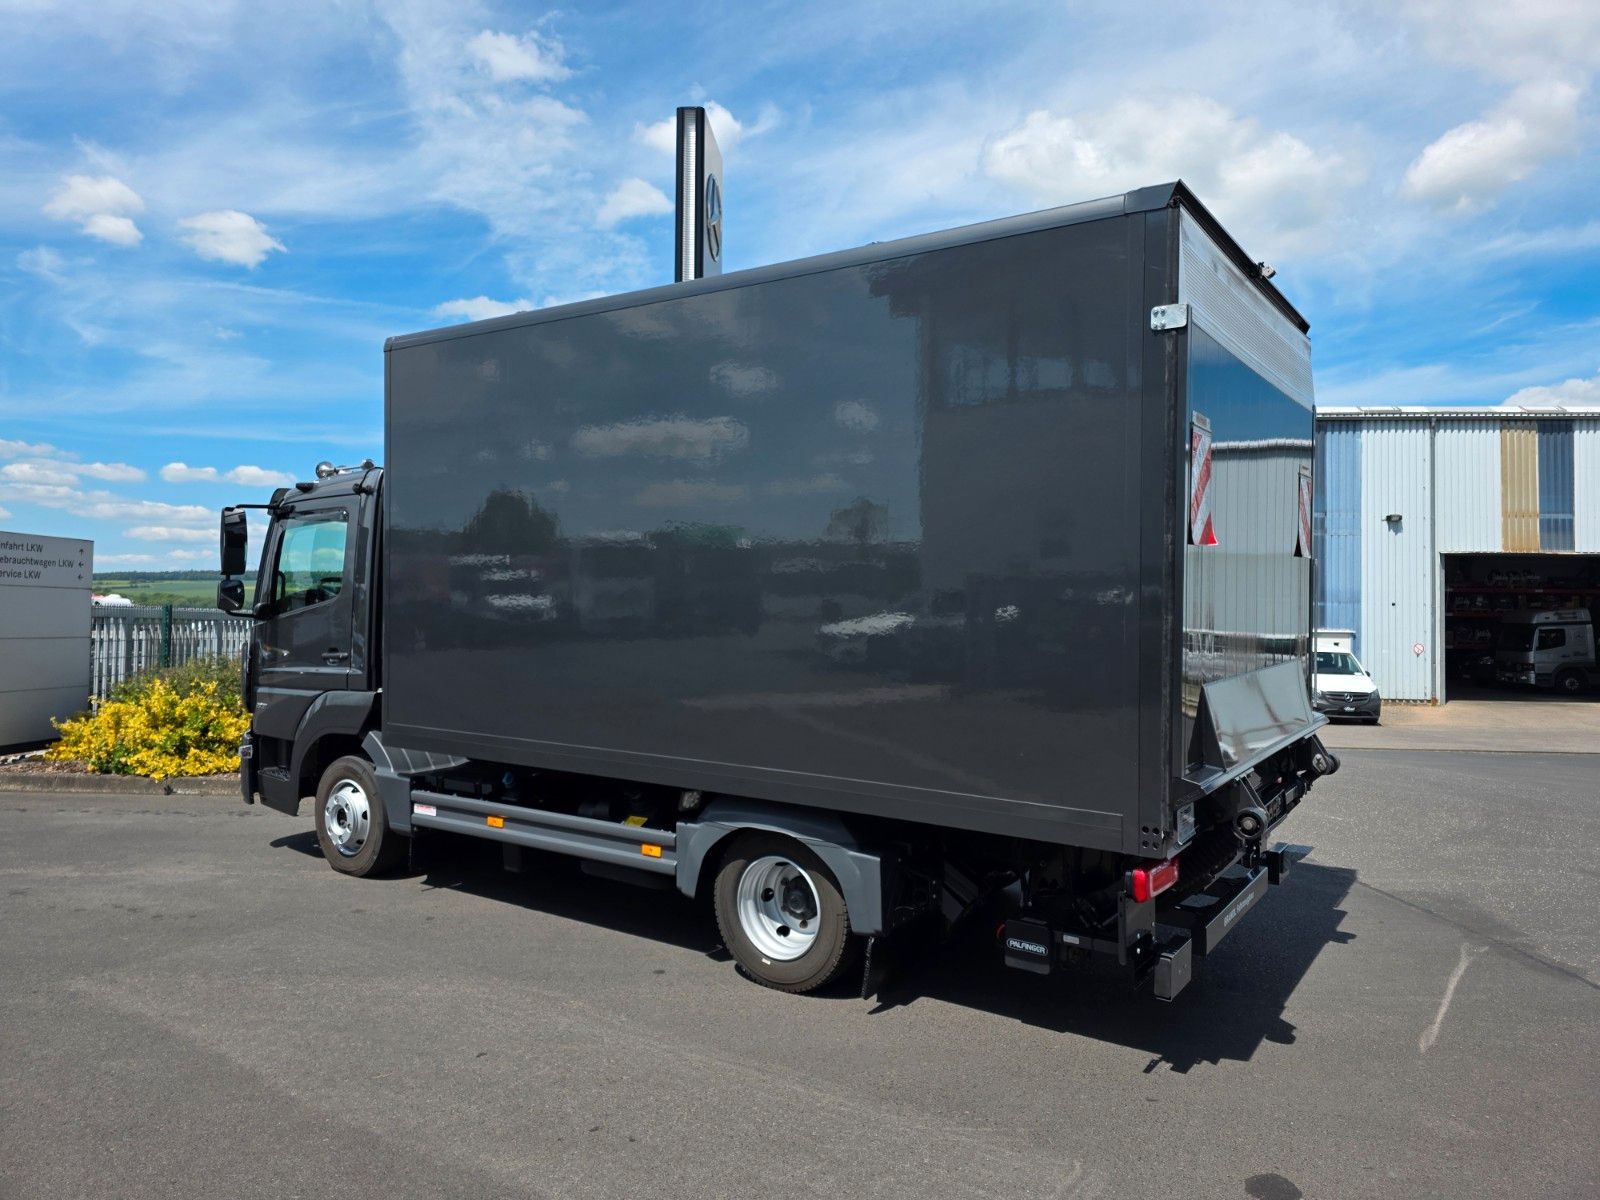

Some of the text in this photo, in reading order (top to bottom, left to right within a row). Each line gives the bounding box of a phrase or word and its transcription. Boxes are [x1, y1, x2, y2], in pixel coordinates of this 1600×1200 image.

[27, 542, 43, 552] LKW
[58, 558, 74, 568] LKW
[24, 569, 41, 579] LKW
[1010, 940, 1046, 954] PALFINGER
